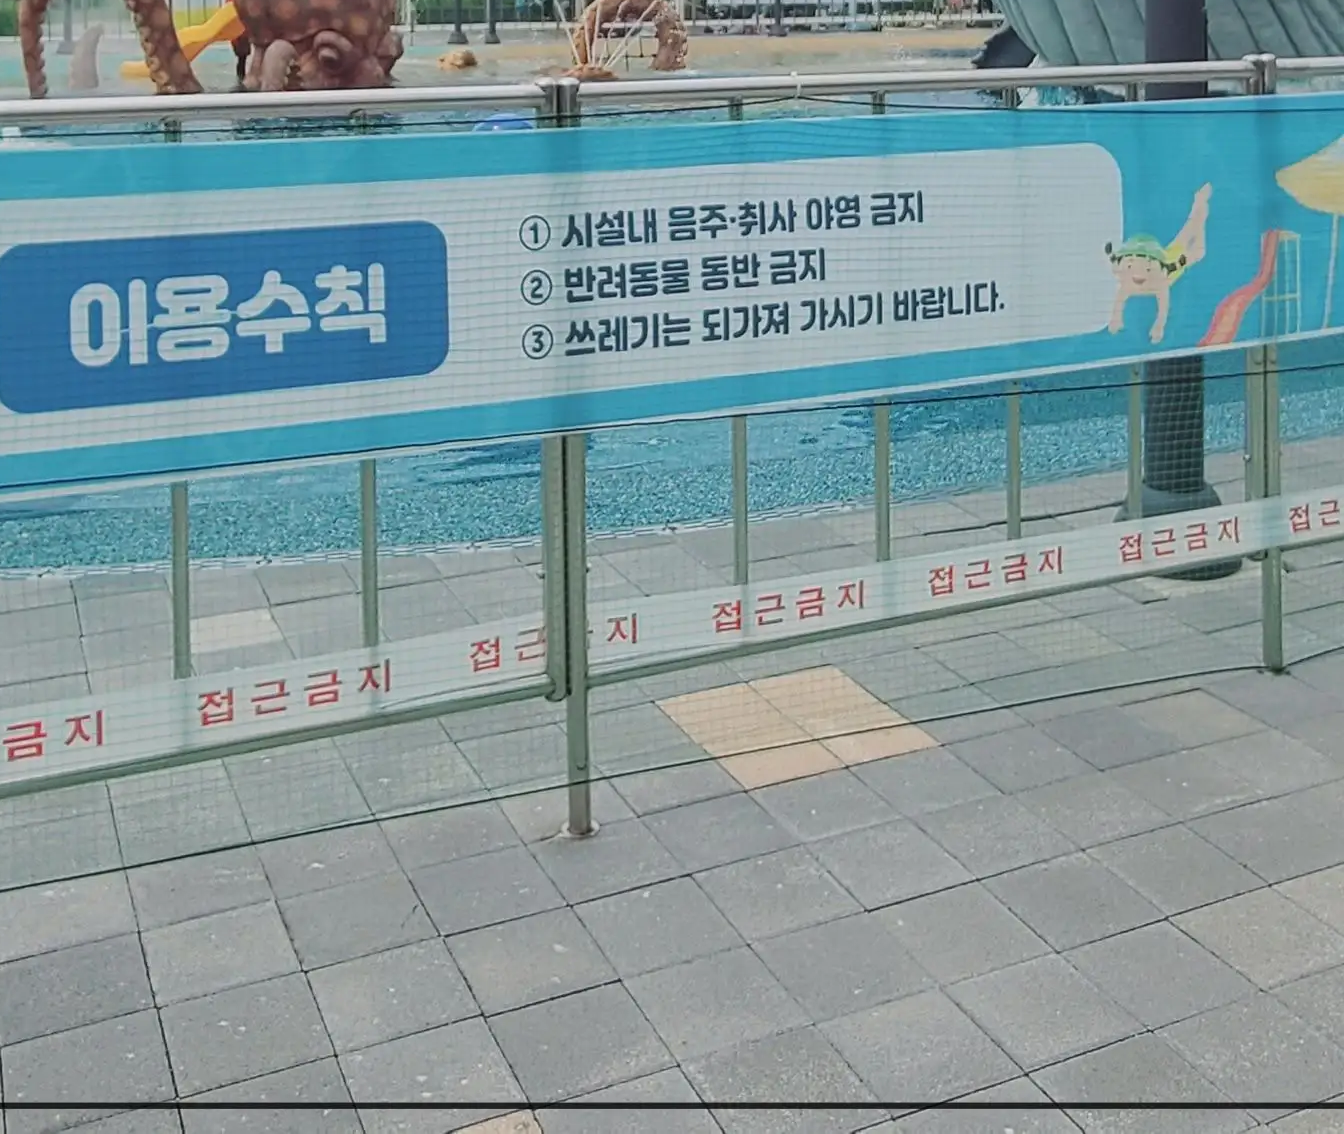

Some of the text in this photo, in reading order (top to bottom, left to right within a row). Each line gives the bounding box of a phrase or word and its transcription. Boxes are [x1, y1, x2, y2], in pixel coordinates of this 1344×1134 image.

[561, 209, 658, 248] 시설내
[806, 194, 861, 230] 야영
[870, 190, 924, 226] 금지
[564, 259, 690, 303] 반려동물
[701, 252, 761, 291] 동반
[769, 247, 827, 286] 금지
[69, 263, 387, 366] 이용수칙
[564, 312, 691, 357] 쓰레기는
[701, 300, 790, 343] 되가져
[800, 292, 884, 333] 가시기
[893, 280, 1006, 323] 바랍니다.
[198, 659, 391, 728] 접근금지
[469, 617, 638, 673] 접근지
[712, 579, 865, 634] 접근금지
[928, 545, 1063, 597] 접근금지
[1119, 517, 1240, 564] 접근금지
